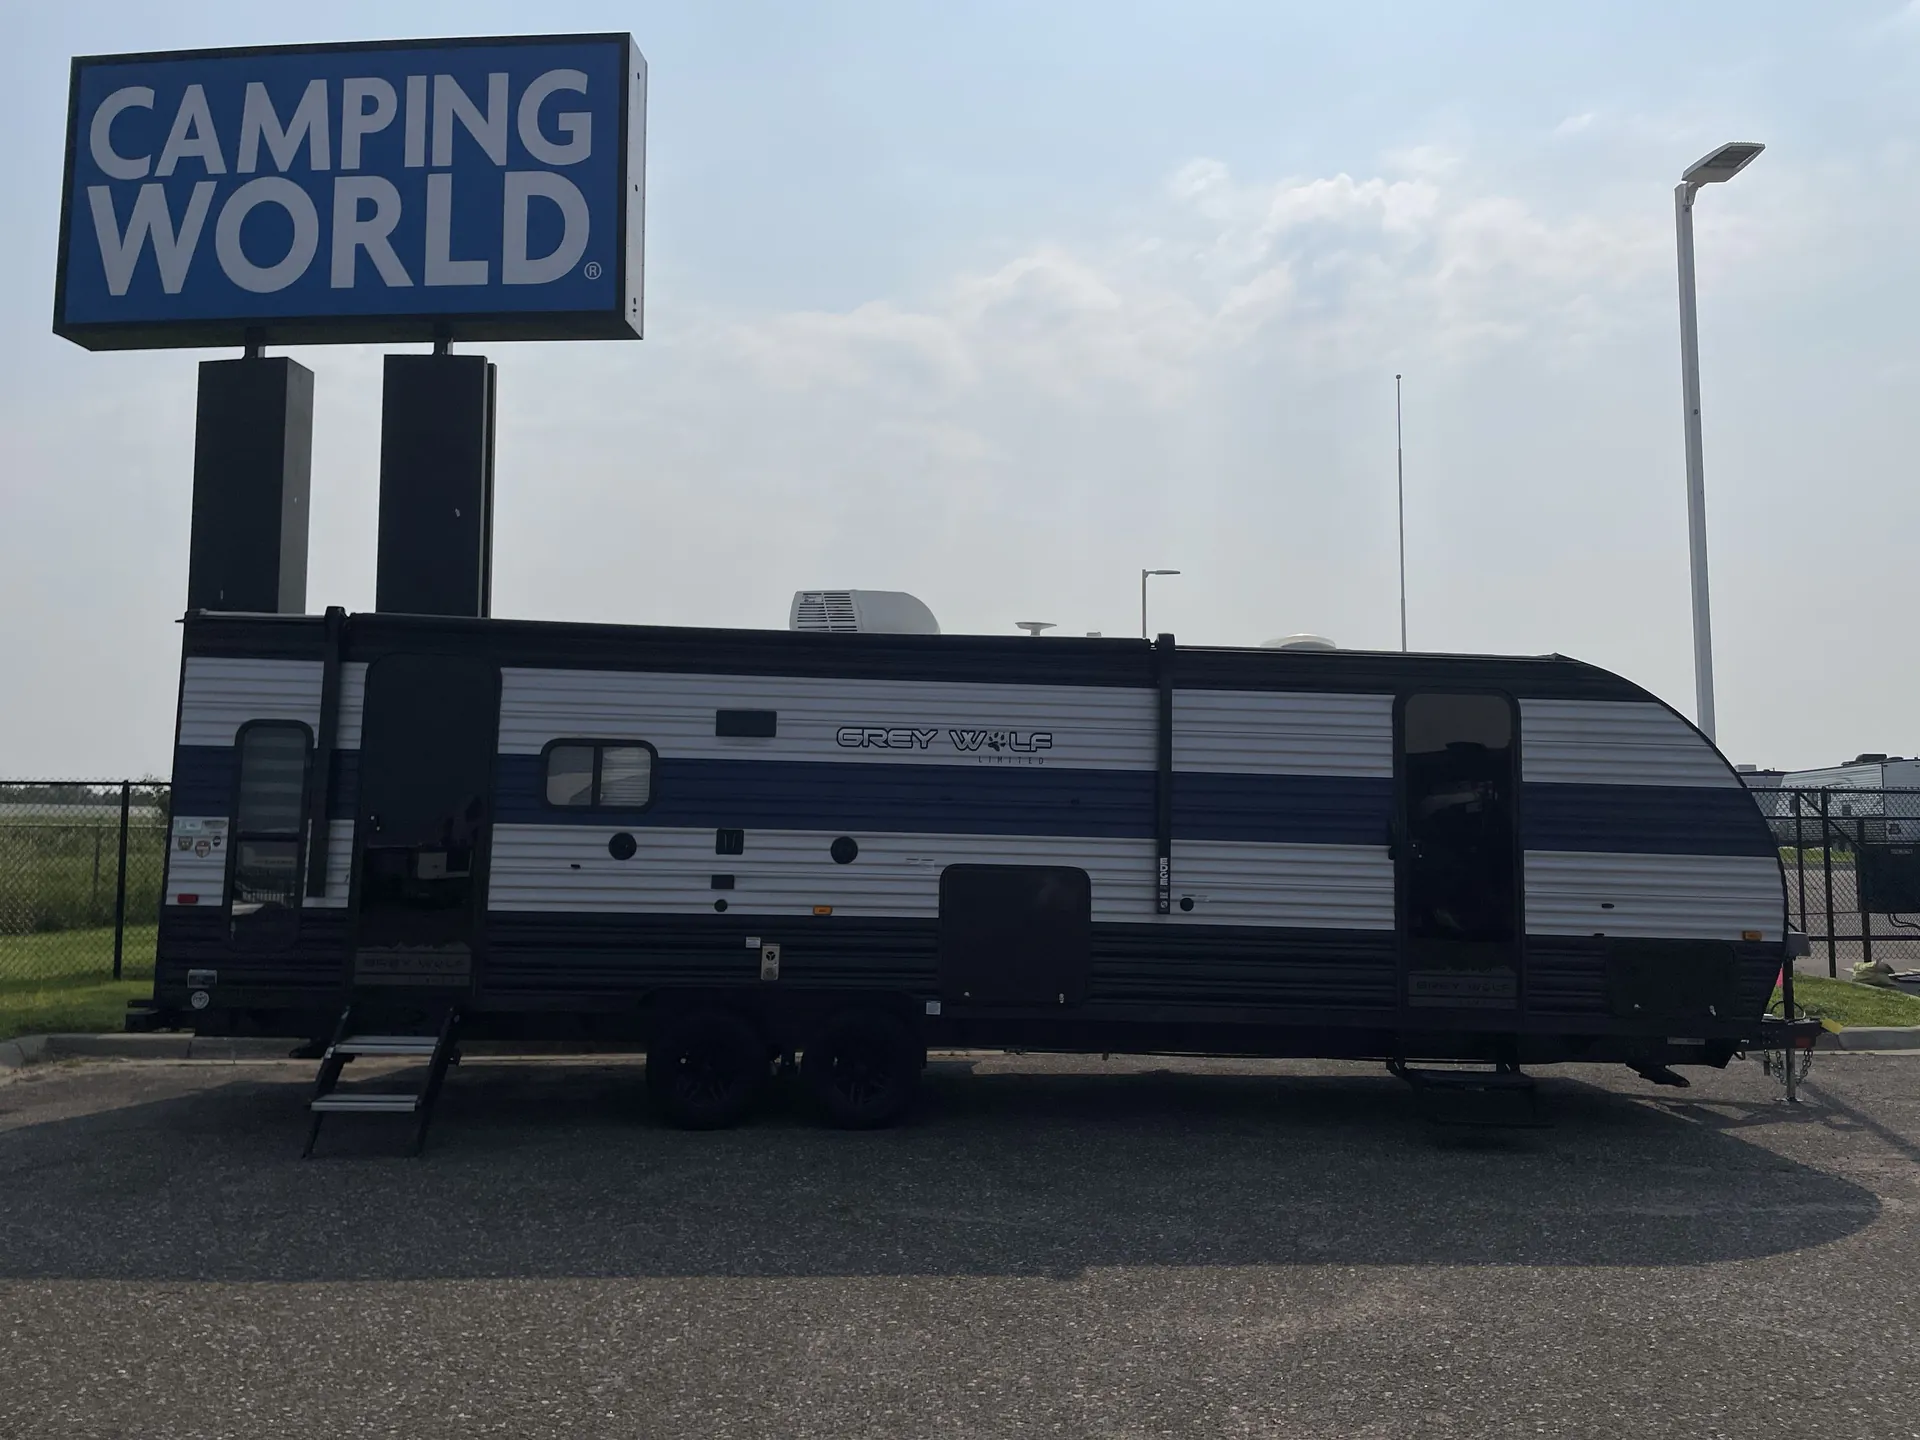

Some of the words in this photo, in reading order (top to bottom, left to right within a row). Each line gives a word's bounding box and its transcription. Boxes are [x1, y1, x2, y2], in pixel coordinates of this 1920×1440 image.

[89, 68, 592, 180] CAMPING
[87, 170, 591, 297] WORLD
[836, 726, 938, 749] GREY
[977, 755, 1044, 765] LIMITED
